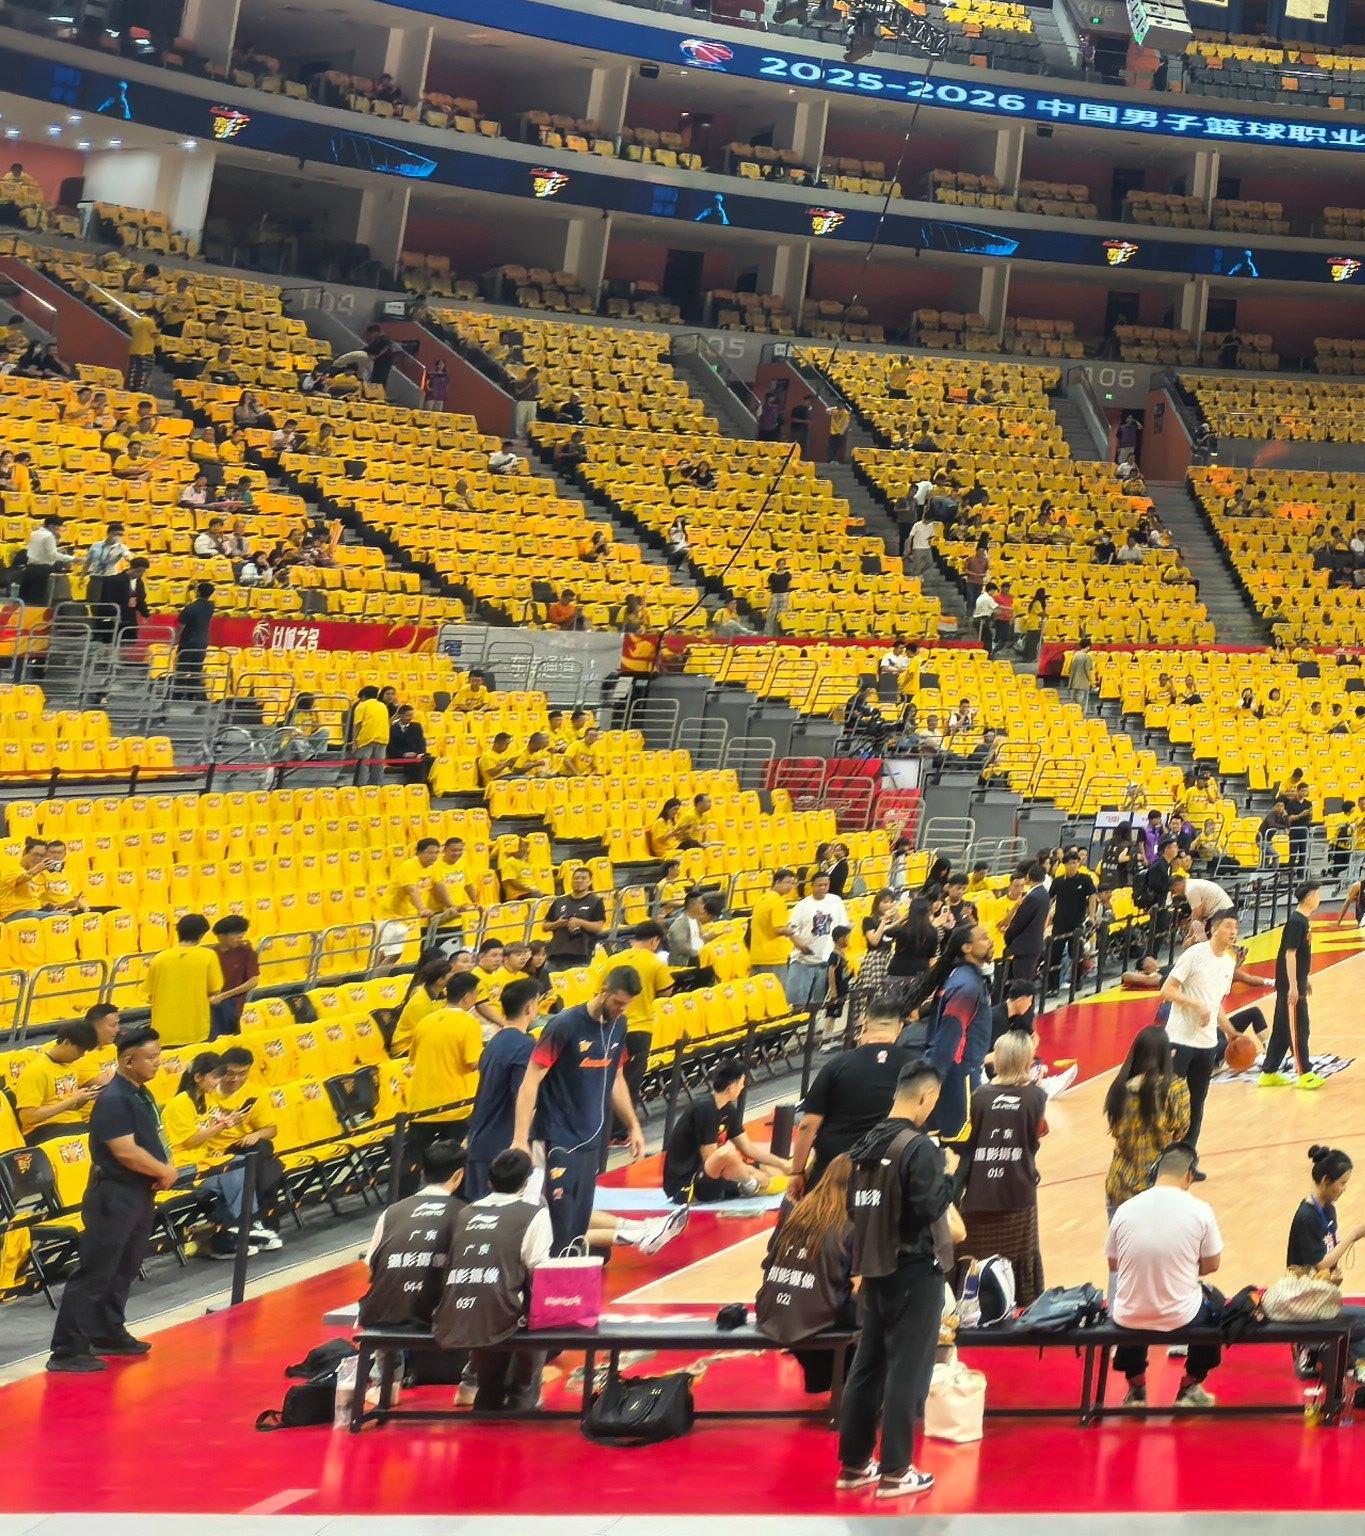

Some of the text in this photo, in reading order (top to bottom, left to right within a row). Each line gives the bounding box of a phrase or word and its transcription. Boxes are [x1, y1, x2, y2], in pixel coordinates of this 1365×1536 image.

[759, 56, 1025, 112] 2025-2026
[1082, 367, 1135, 389] 106
[455, 1296, 477, 1311] 037
